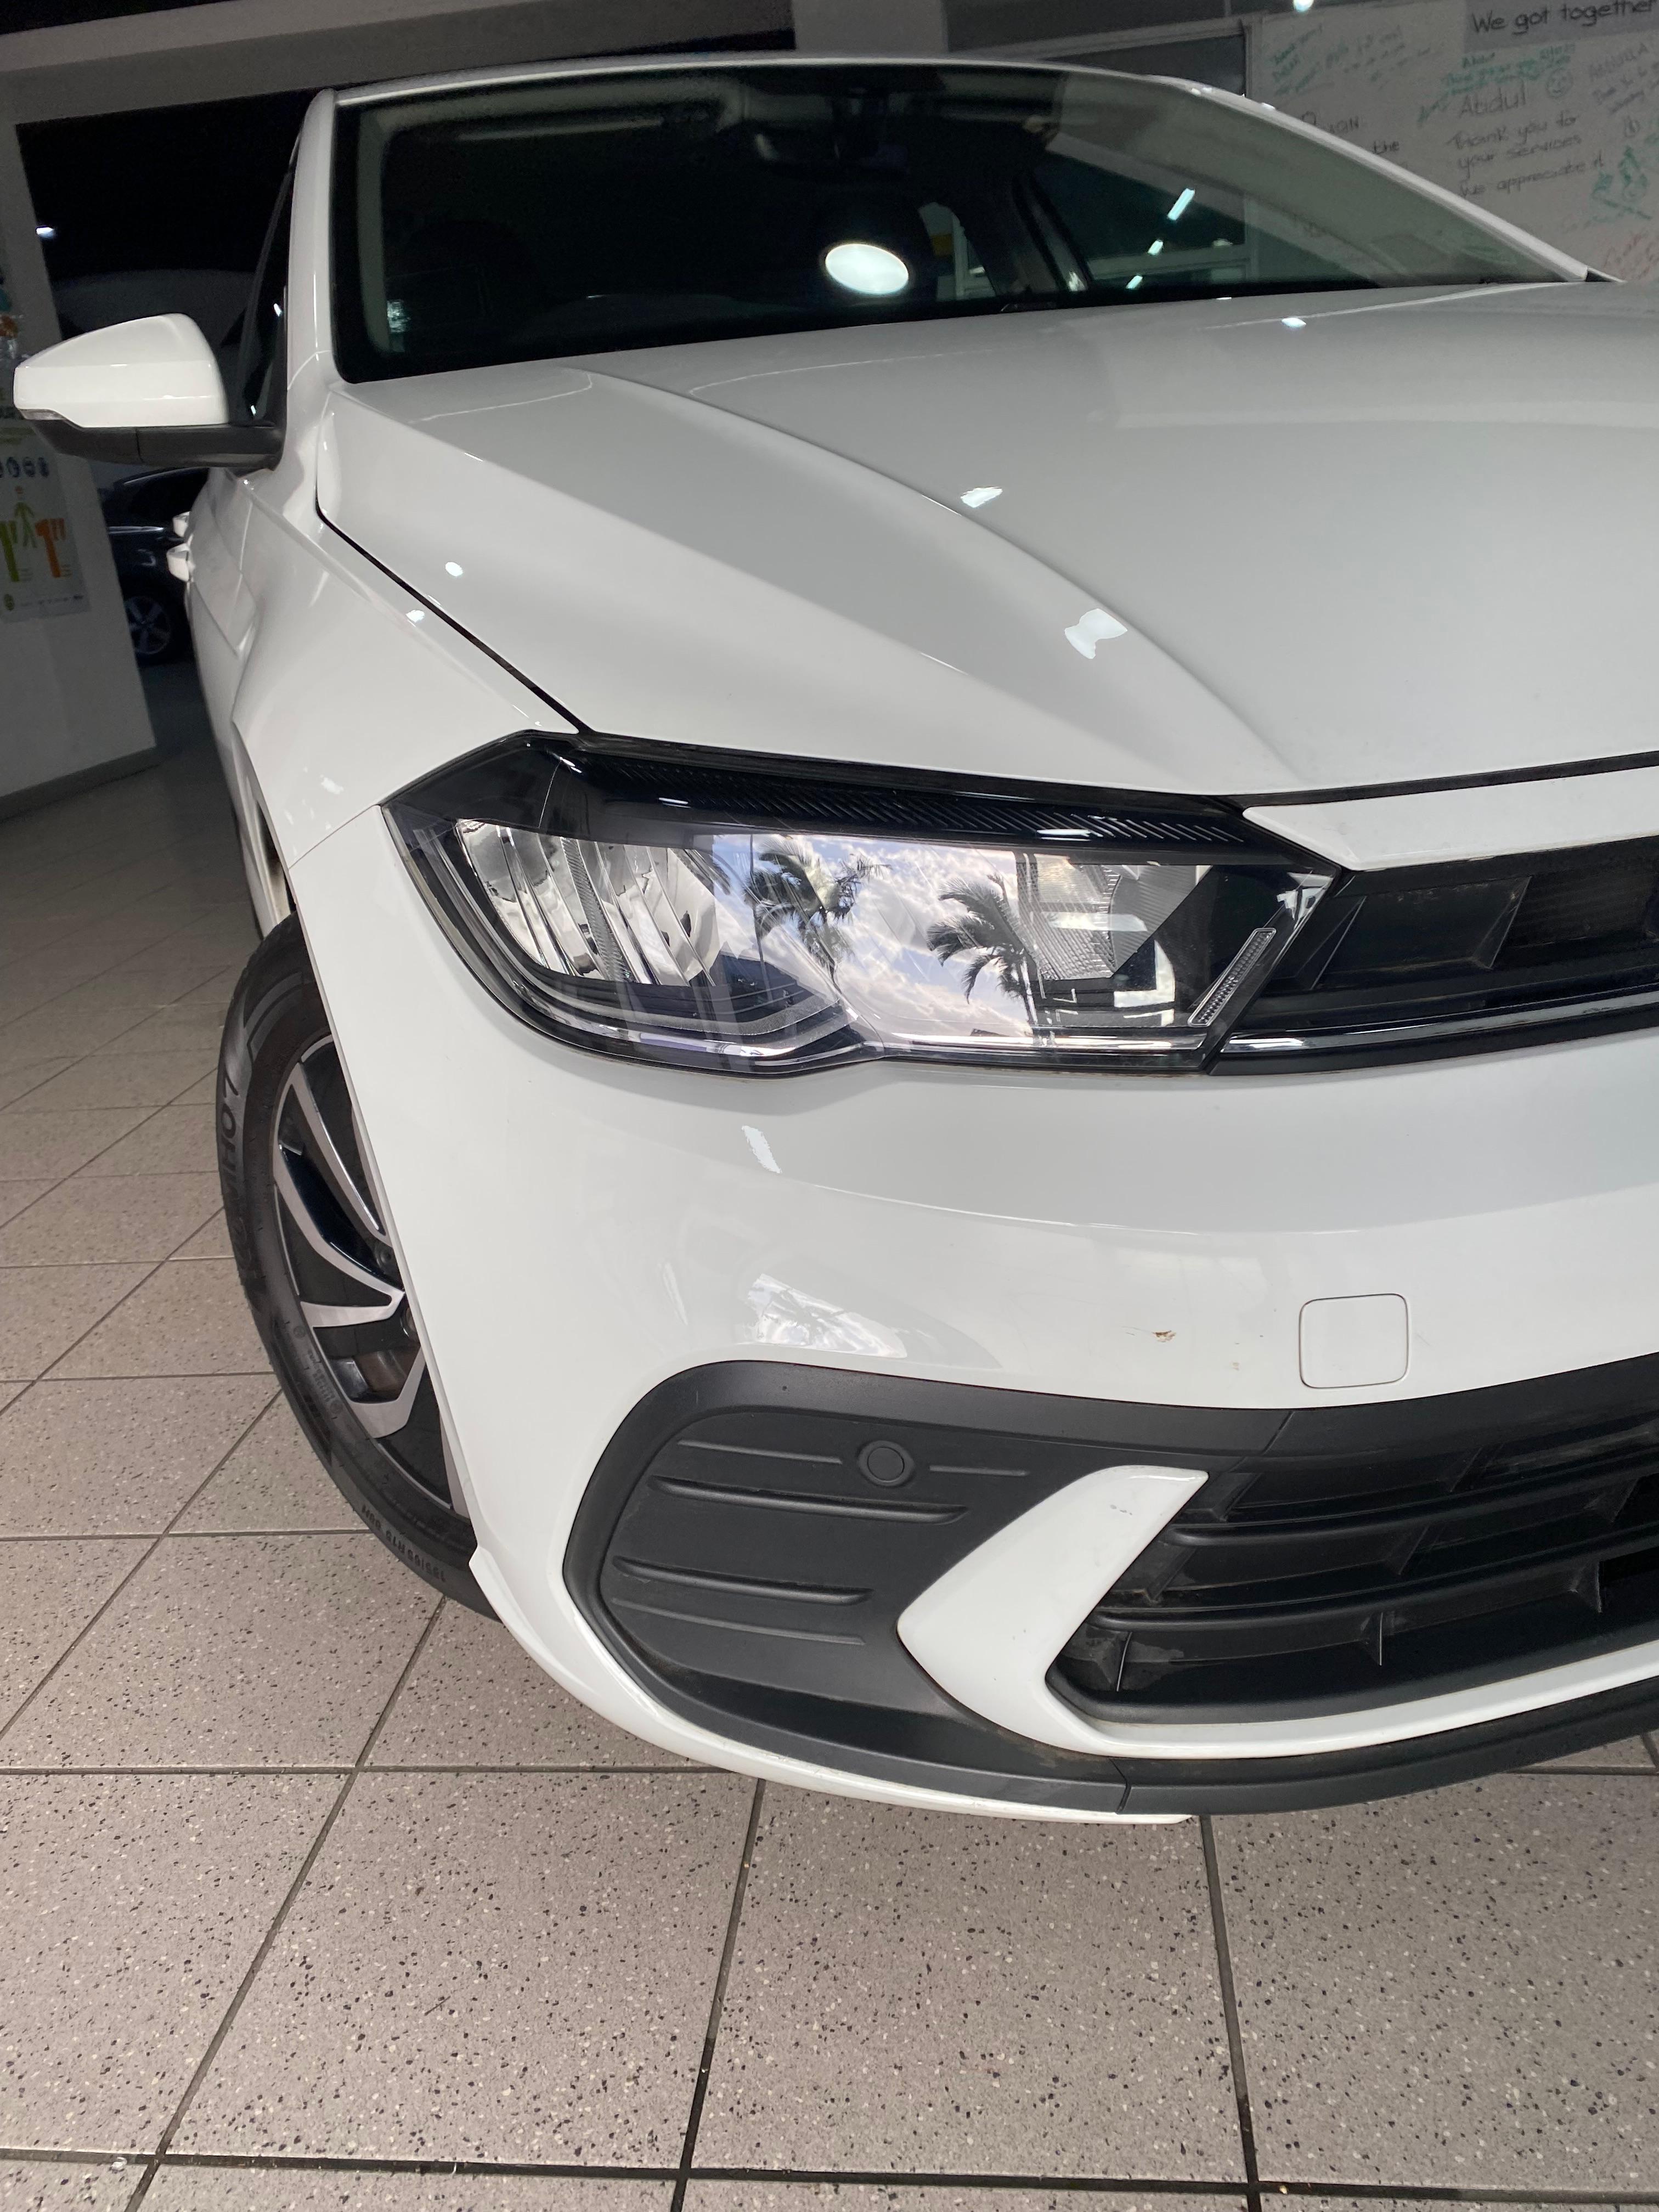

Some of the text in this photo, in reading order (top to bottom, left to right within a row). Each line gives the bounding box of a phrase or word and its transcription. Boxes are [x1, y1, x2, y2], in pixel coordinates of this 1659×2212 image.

[1472, 0, 1655, 36] We got together
